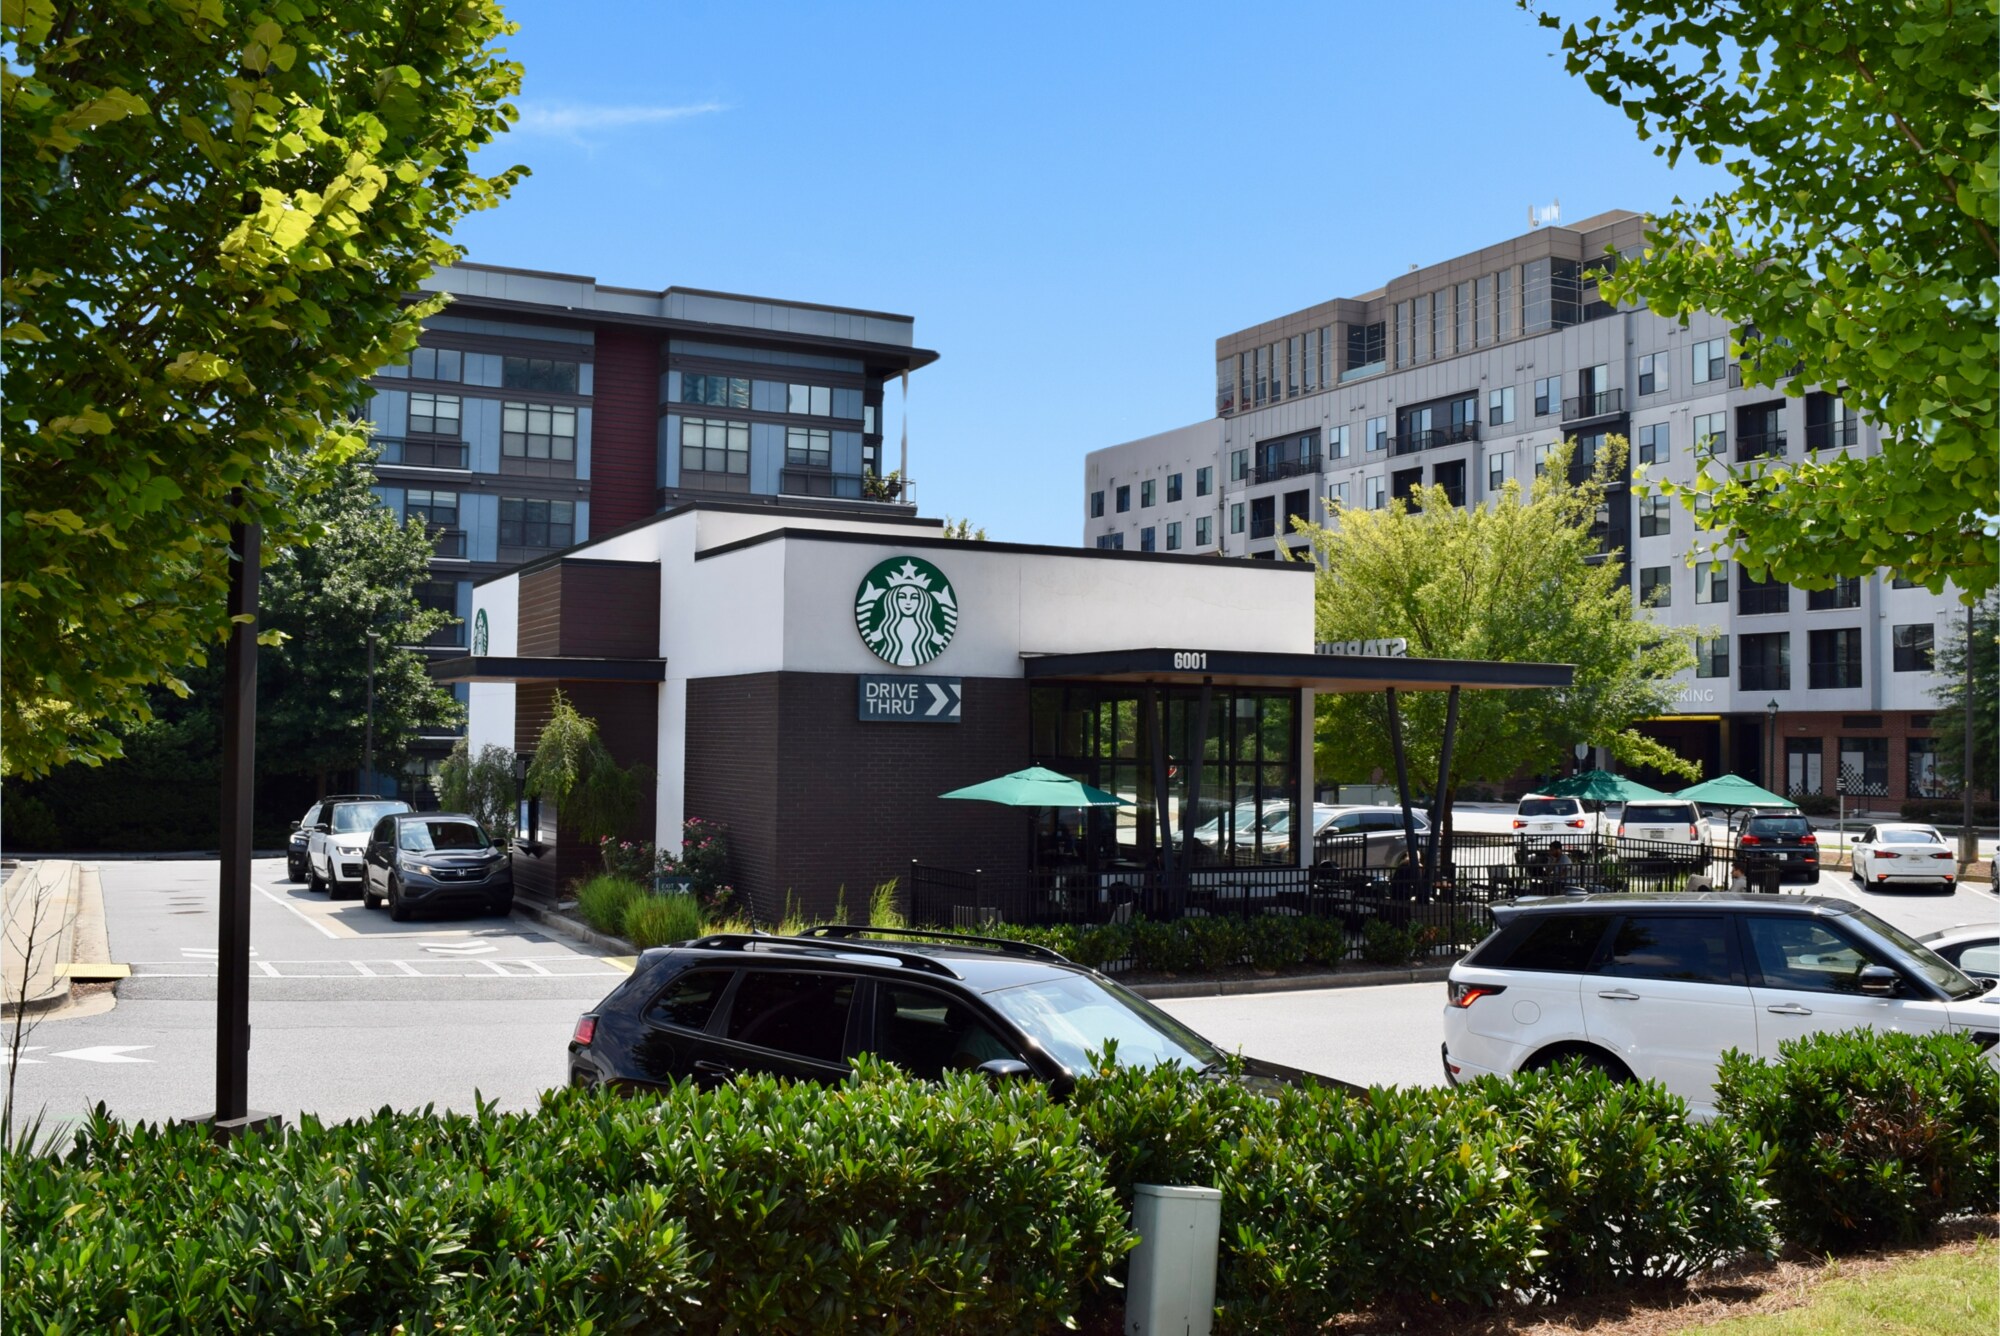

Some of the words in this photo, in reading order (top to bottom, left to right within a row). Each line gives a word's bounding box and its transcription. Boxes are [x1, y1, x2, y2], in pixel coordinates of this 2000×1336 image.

[1174, 652, 1207, 669] 6001
[866, 682, 919, 699] DRIVE
[1671, 689, 1714, 702] KING
[866, 698, 915, 715] THRU
